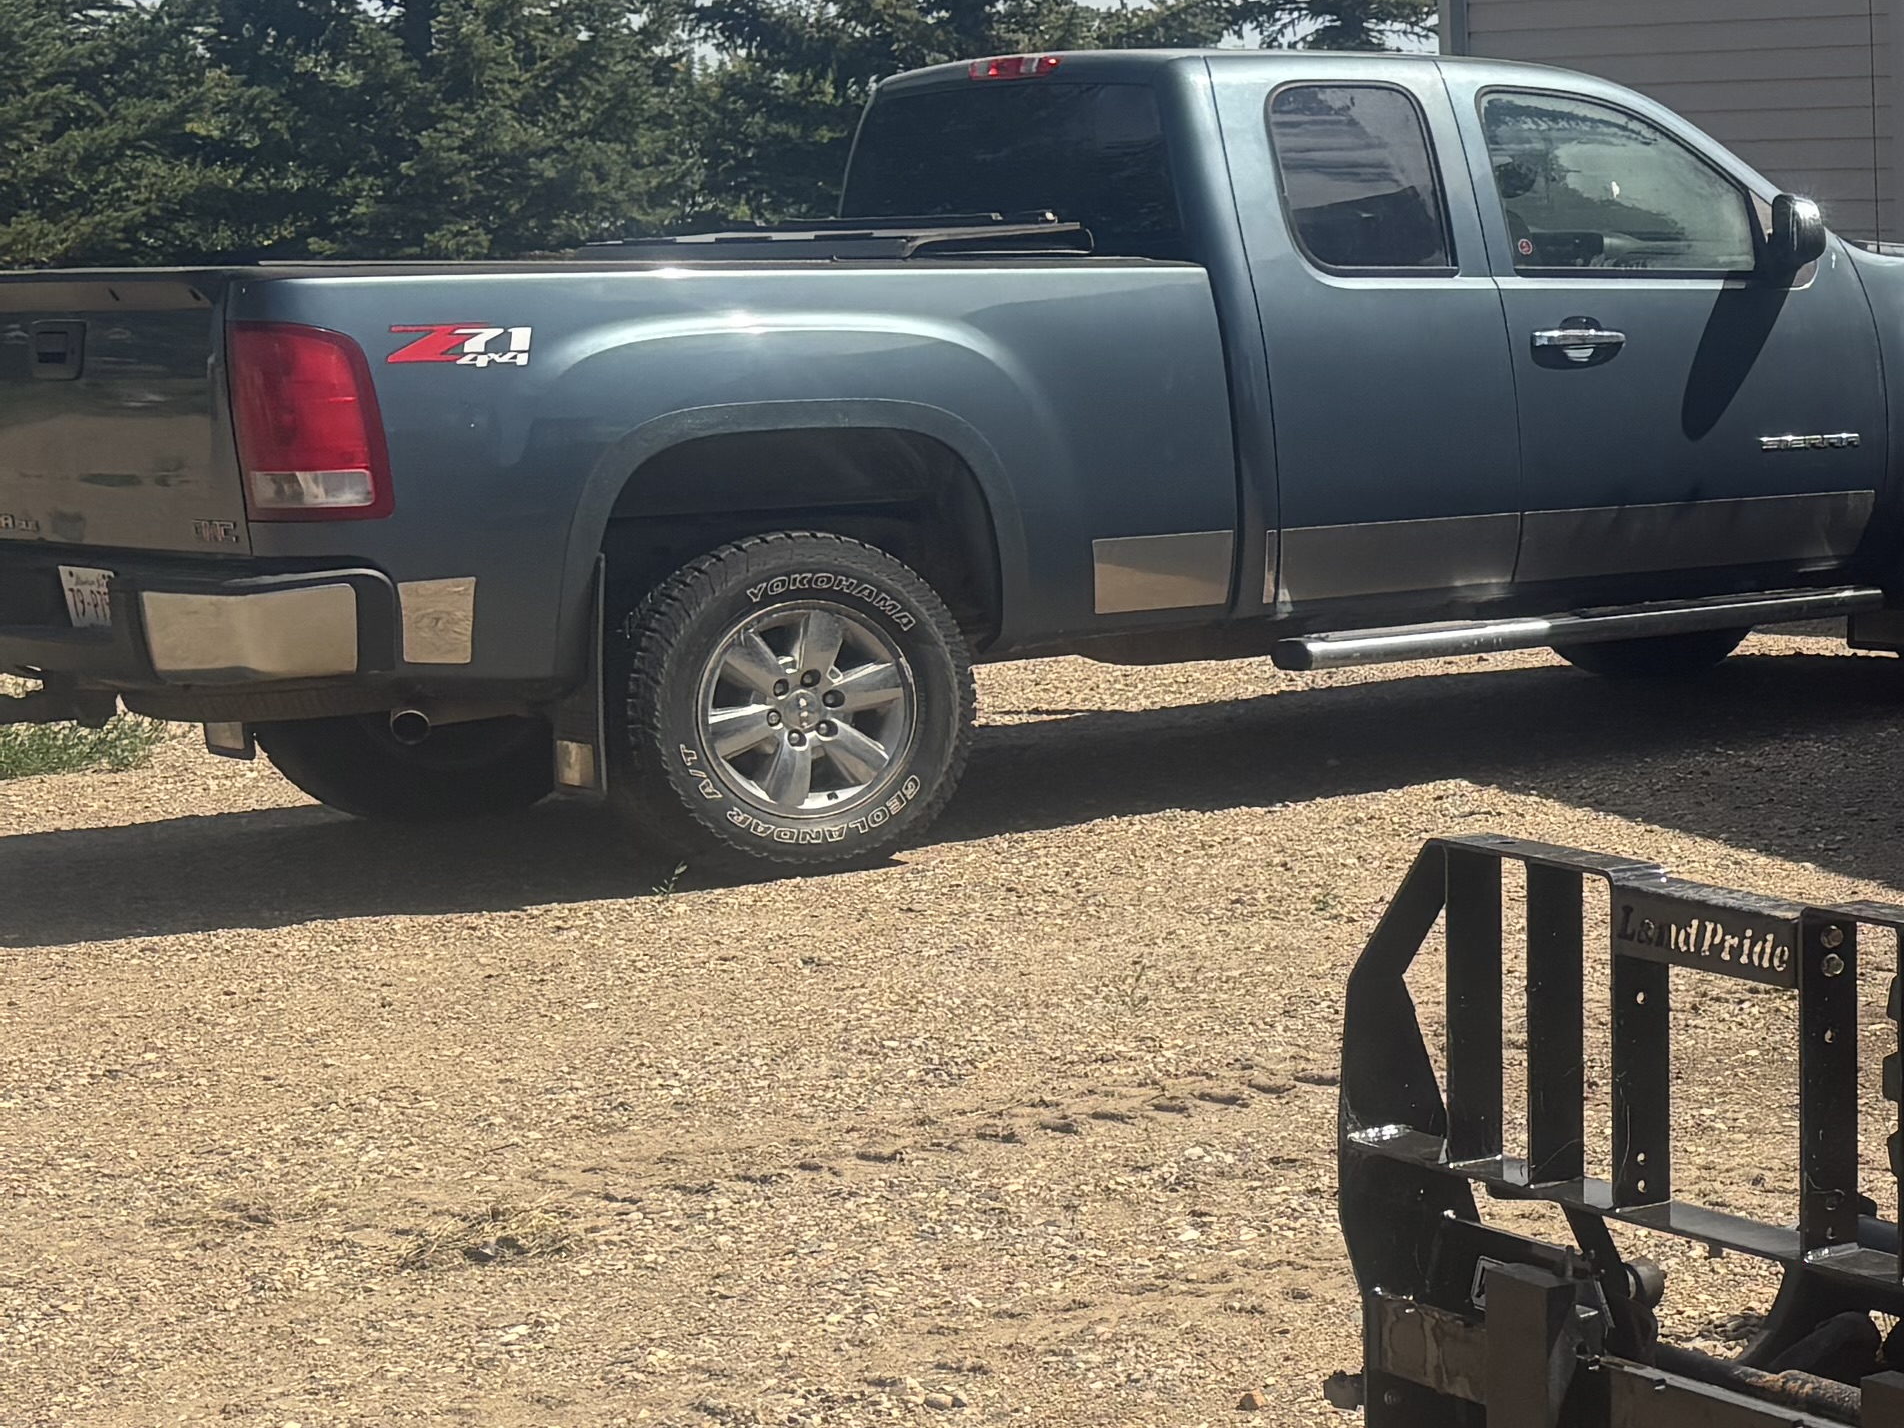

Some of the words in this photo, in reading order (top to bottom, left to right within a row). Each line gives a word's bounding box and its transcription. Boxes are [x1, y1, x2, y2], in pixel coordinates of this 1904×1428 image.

[387, 322, 532, 363] Z71
[1759, 432, 1859, 450] SIERRA
[747, 573, 915, 632] YOKOHAMA
[680, 743, 724, 799] A/T
[727, 774, 921, 844] GEOLANDAR
